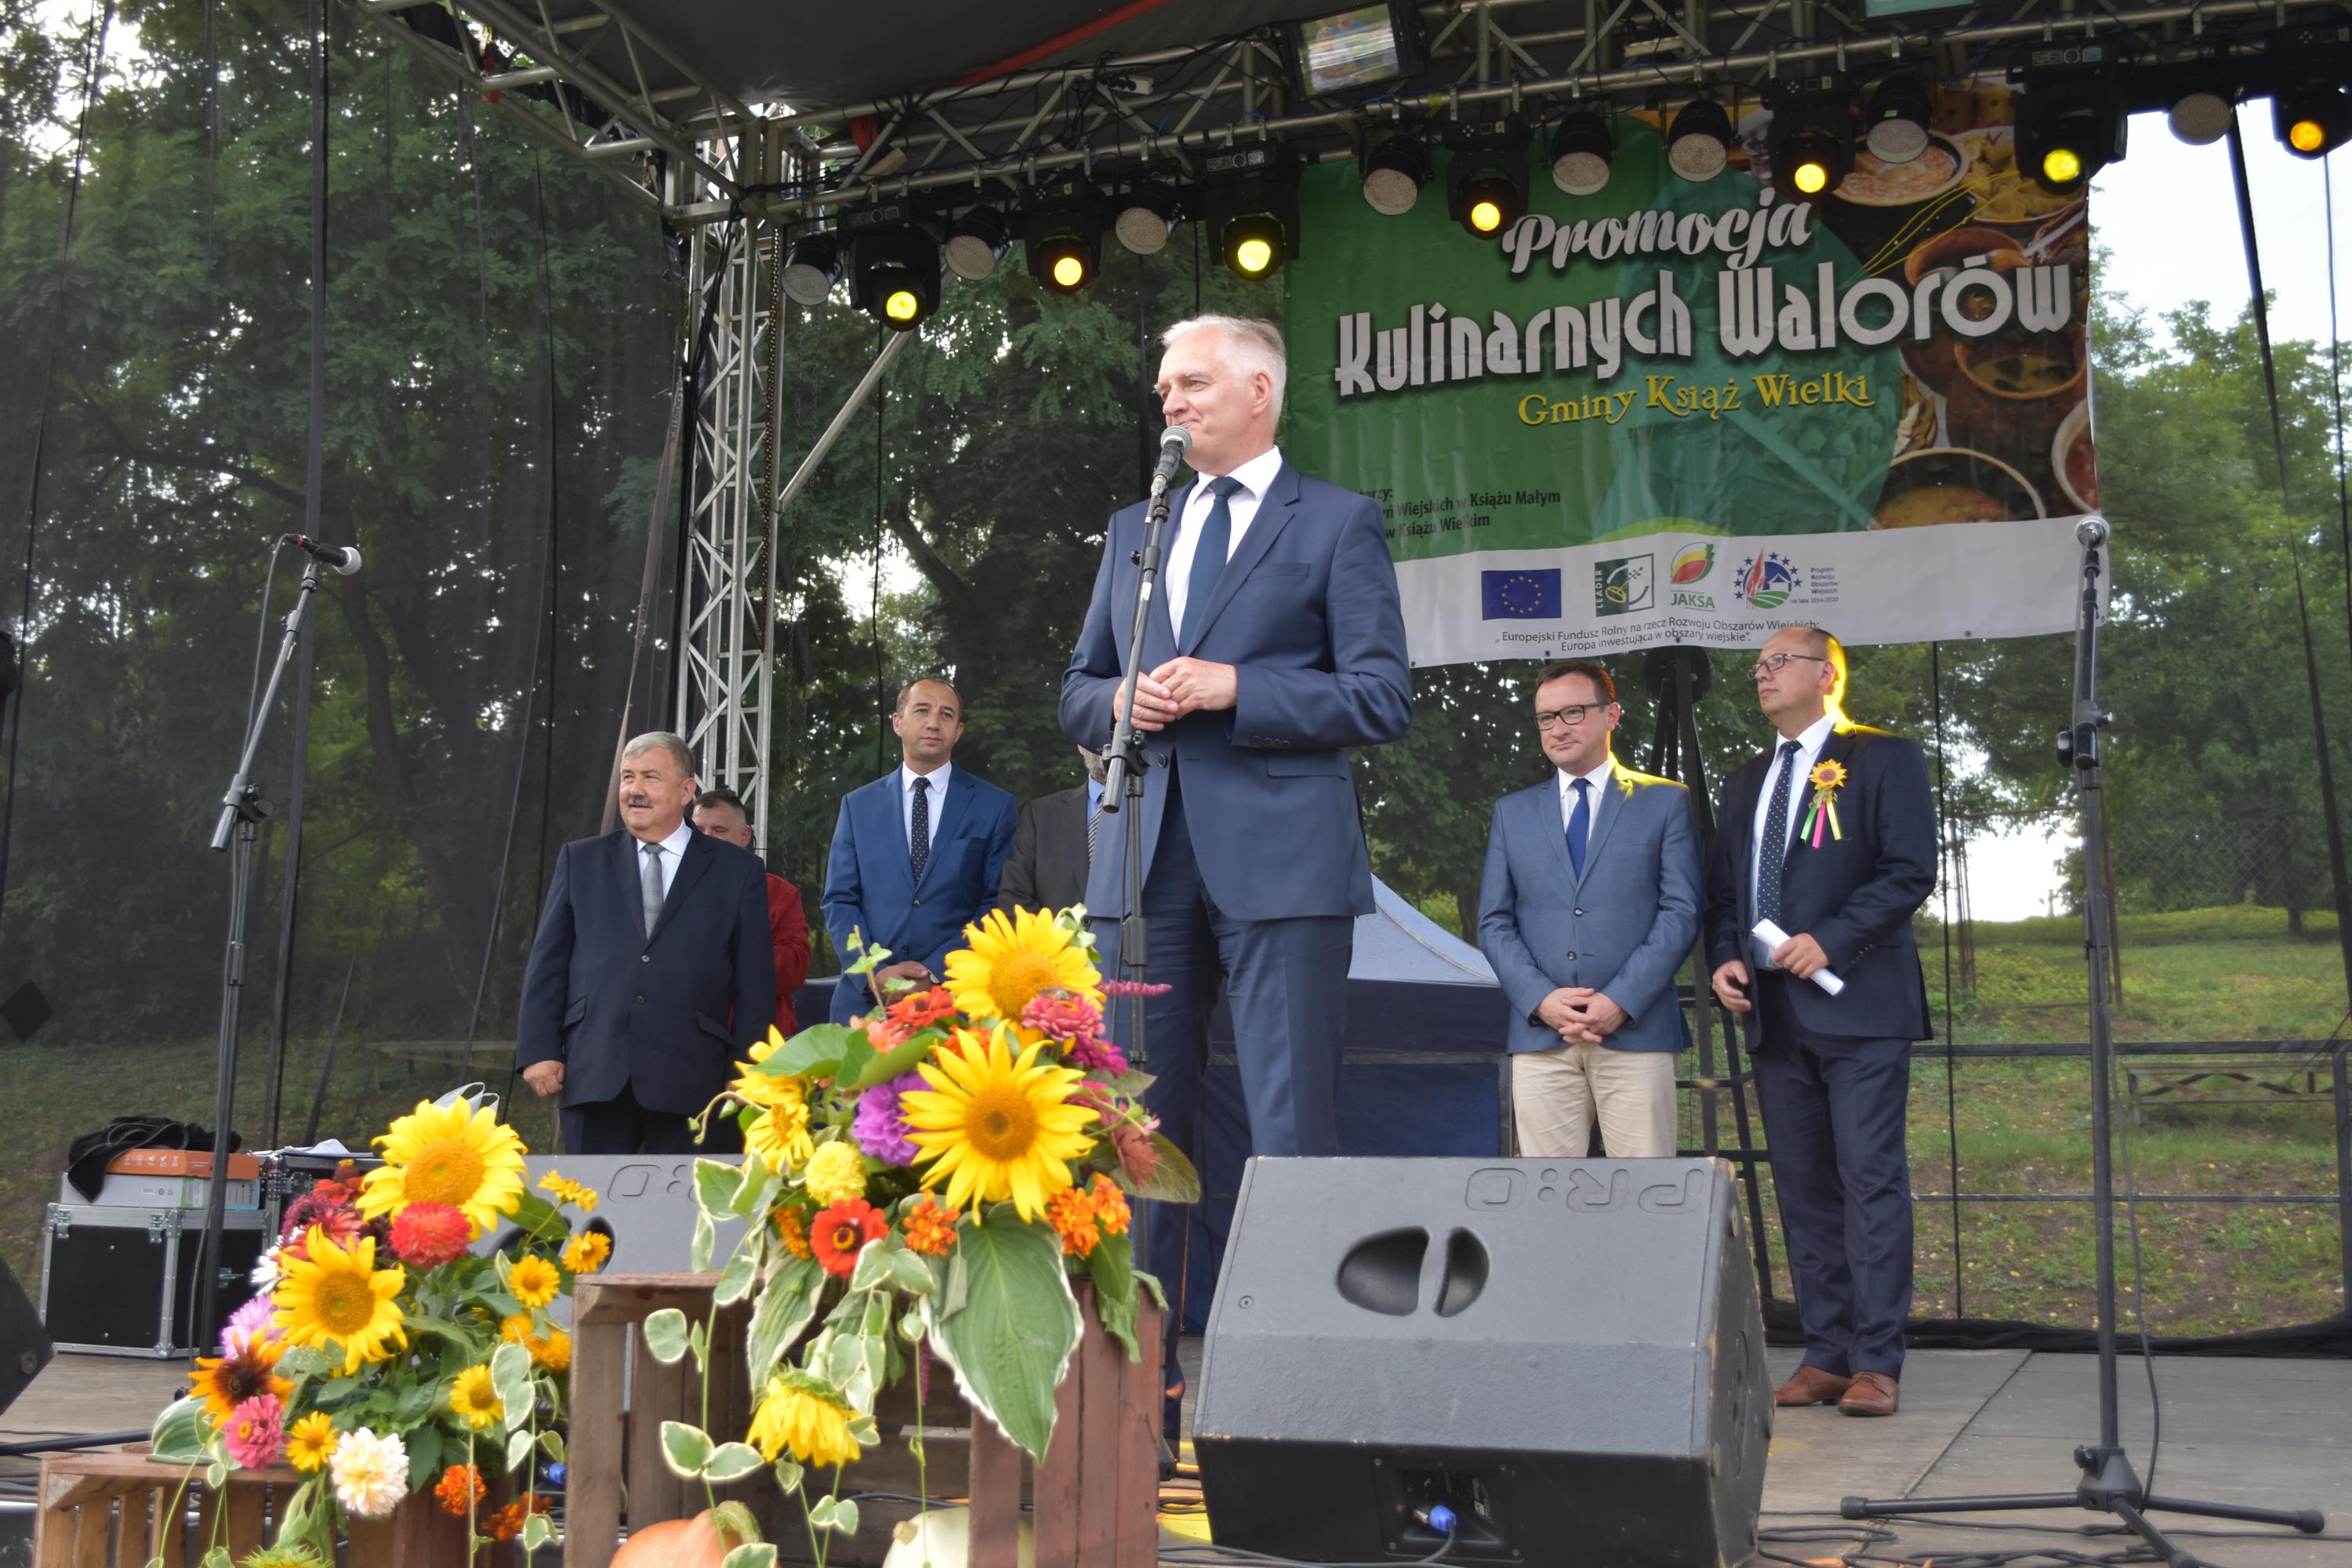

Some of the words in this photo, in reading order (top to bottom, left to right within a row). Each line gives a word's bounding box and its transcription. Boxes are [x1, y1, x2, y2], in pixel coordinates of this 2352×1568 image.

[1502, 187, 1813, 273] Promocja
[1334, 269, 1691, 397] Kulinarnych
[1719, 253, 2071, 358] Walorów
[1518, 390, 1637, 426] Gminy
[1646, 376, 1742, 420] Książ
[1752, 372, 1875, 408] Wielki
[1397, 497, 1454, 518] Wiejskich
[1457, 498, 1468, 509] w
[1470, 492, 1512, 510] Książu
[1515, 490, 1561, 507] Małym
[1399, 521, 1437, 539] Książu
[1439, 514, 1490, 531] Wielkim
[1595, 569, 1604, 609] LEADER
[1670, 593, 1715, 609] JAKSA
[1501, 631, 1555, 644] Europejski
[1558, 629, 1599, 641] Fundusz
[1602, 626, 1628, 637] Rolny
[1630, 624, 1642, 633] na
[1644, 619, 1667, 630] rzecz
[1668, 616, 1711, 630] Rozwoju
[1713, 619, 1764, 631] Obszarów
[1561, 641, 1596, 652] Europa
[1598, 633, 1653, 648] inwestująca
[1664, 628, 1704, 641] obszary
